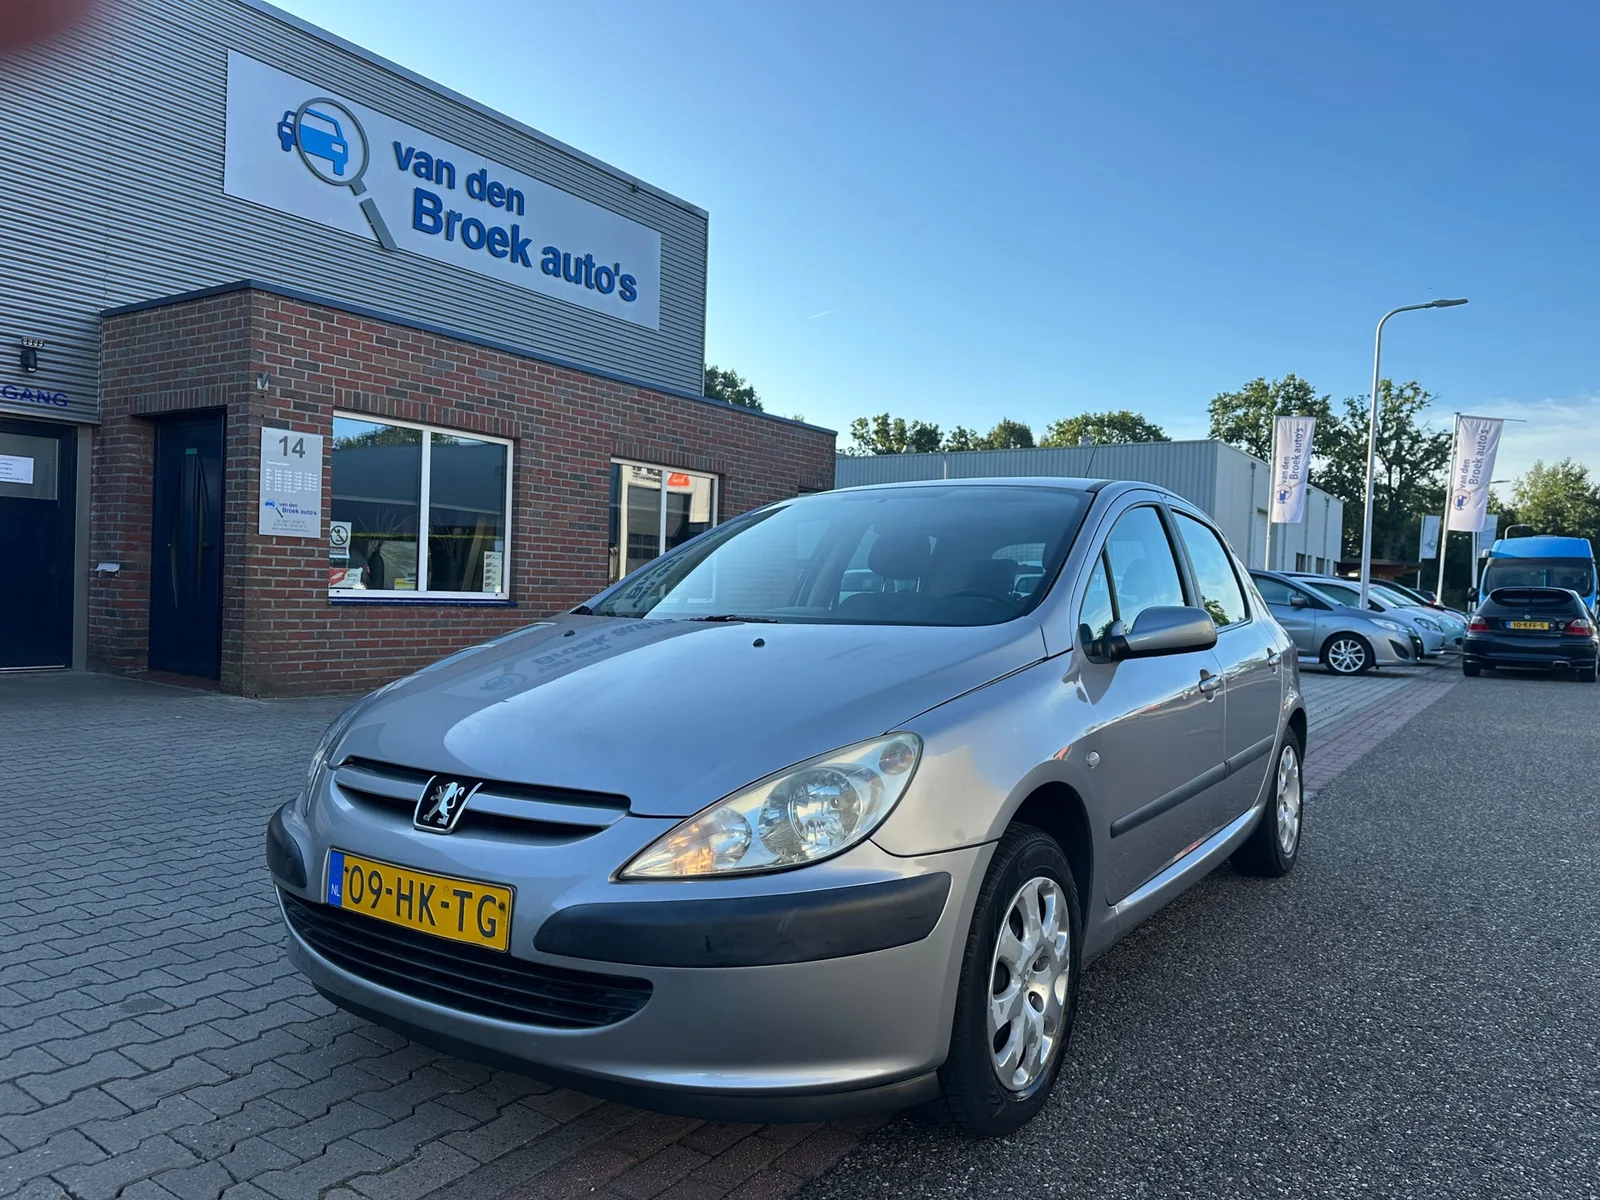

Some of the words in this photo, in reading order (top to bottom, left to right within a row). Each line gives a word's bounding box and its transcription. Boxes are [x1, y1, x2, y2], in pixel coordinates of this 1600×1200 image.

[393, 140, 456, 190] van
[465, 167, 525, 217] den
[412, 186, 533, 269] Broek
[541, 245, 638, 303] auto's
[278, 435, 306, 459] 14
[1294, 427, 1304, 454] auto's
[1281, 455, 1291, 470] den
[1289, 454, 1302, 480] Broek
[1460, 458, 1471, 474] den
[1468, 458, 1484, 485] Broek
[1476, 428, 1490, 457] auto's
[1281, 470, 1289, 485] van
[1460, 474, 1468, 490] van
[330, 882, 341, 898] NL
[348, 864, 498, 938] 09-HK-TG
